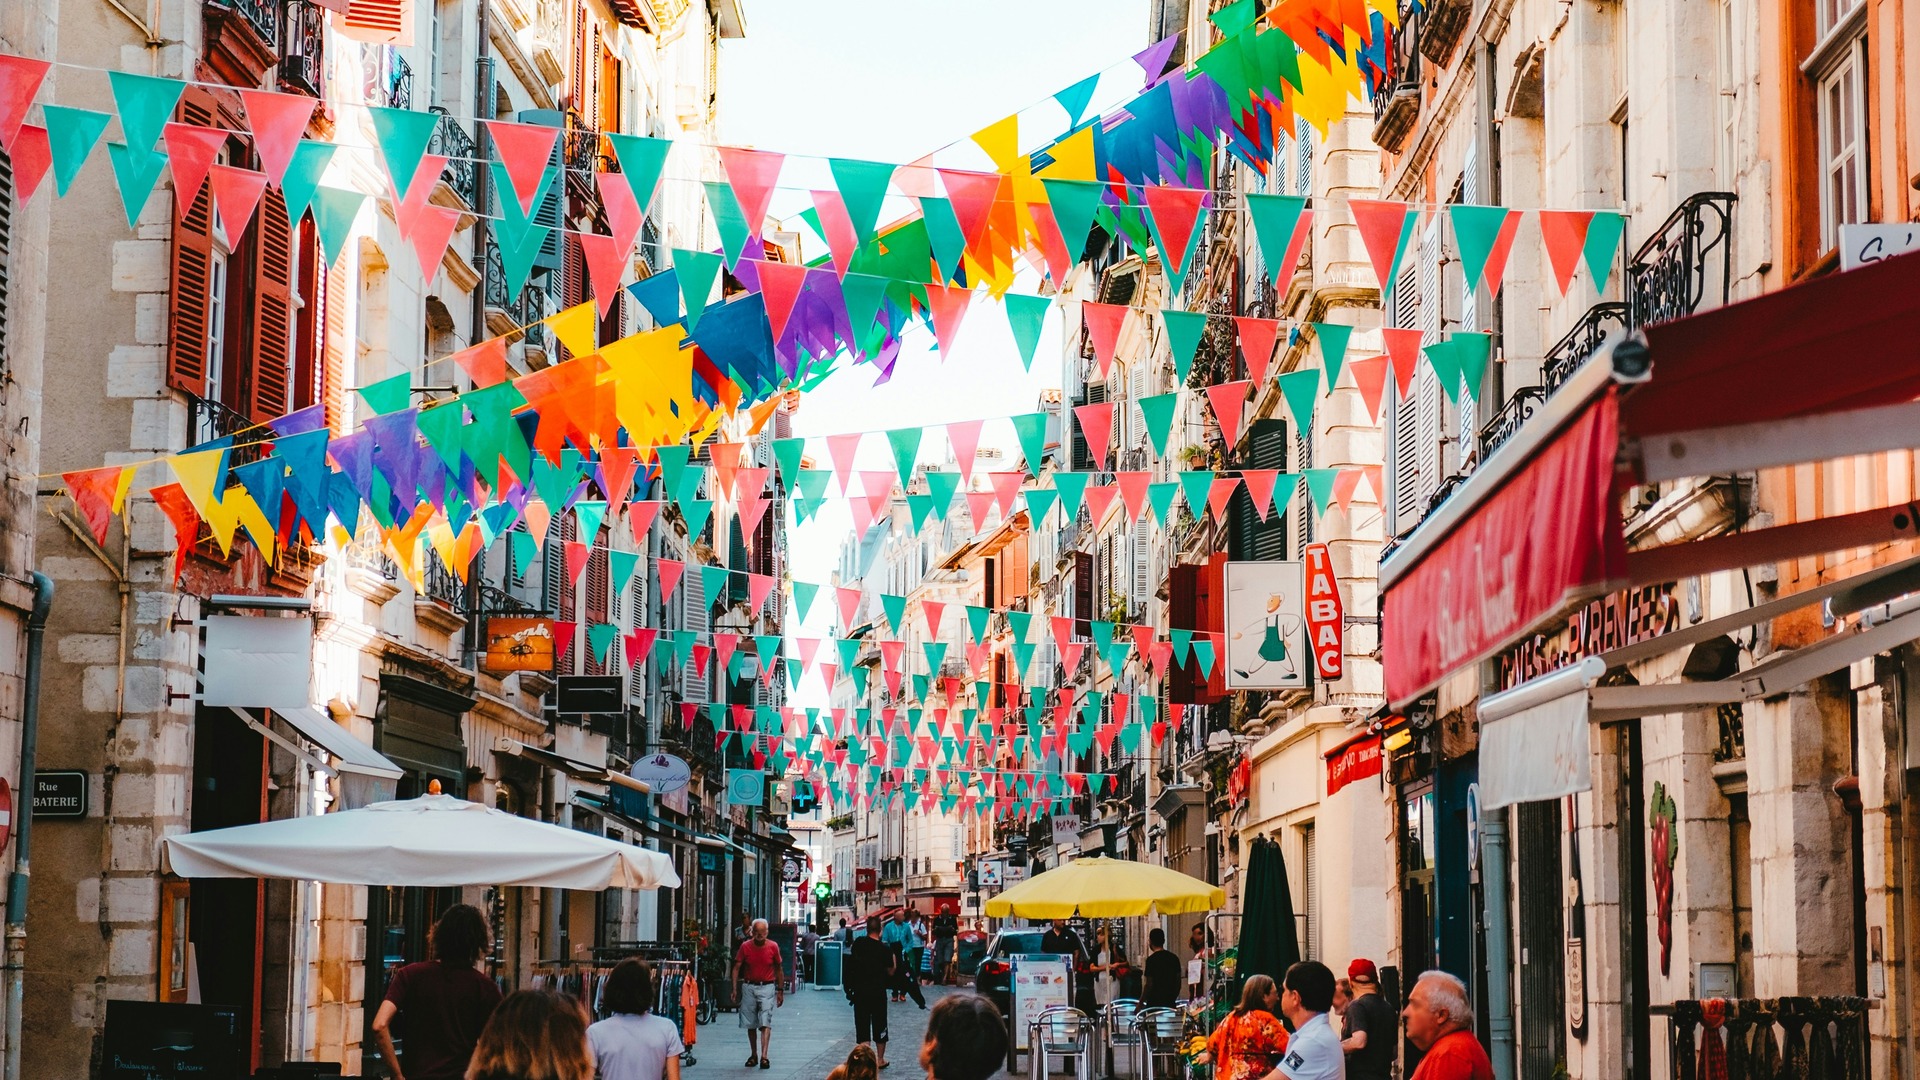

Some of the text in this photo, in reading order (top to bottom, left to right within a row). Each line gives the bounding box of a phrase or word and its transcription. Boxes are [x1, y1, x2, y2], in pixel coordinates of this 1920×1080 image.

[1308, 548, 1340, 673] TABAC
[39, 782, 58, 791] Rue
[33, 797, 78, 807] BATERIE
